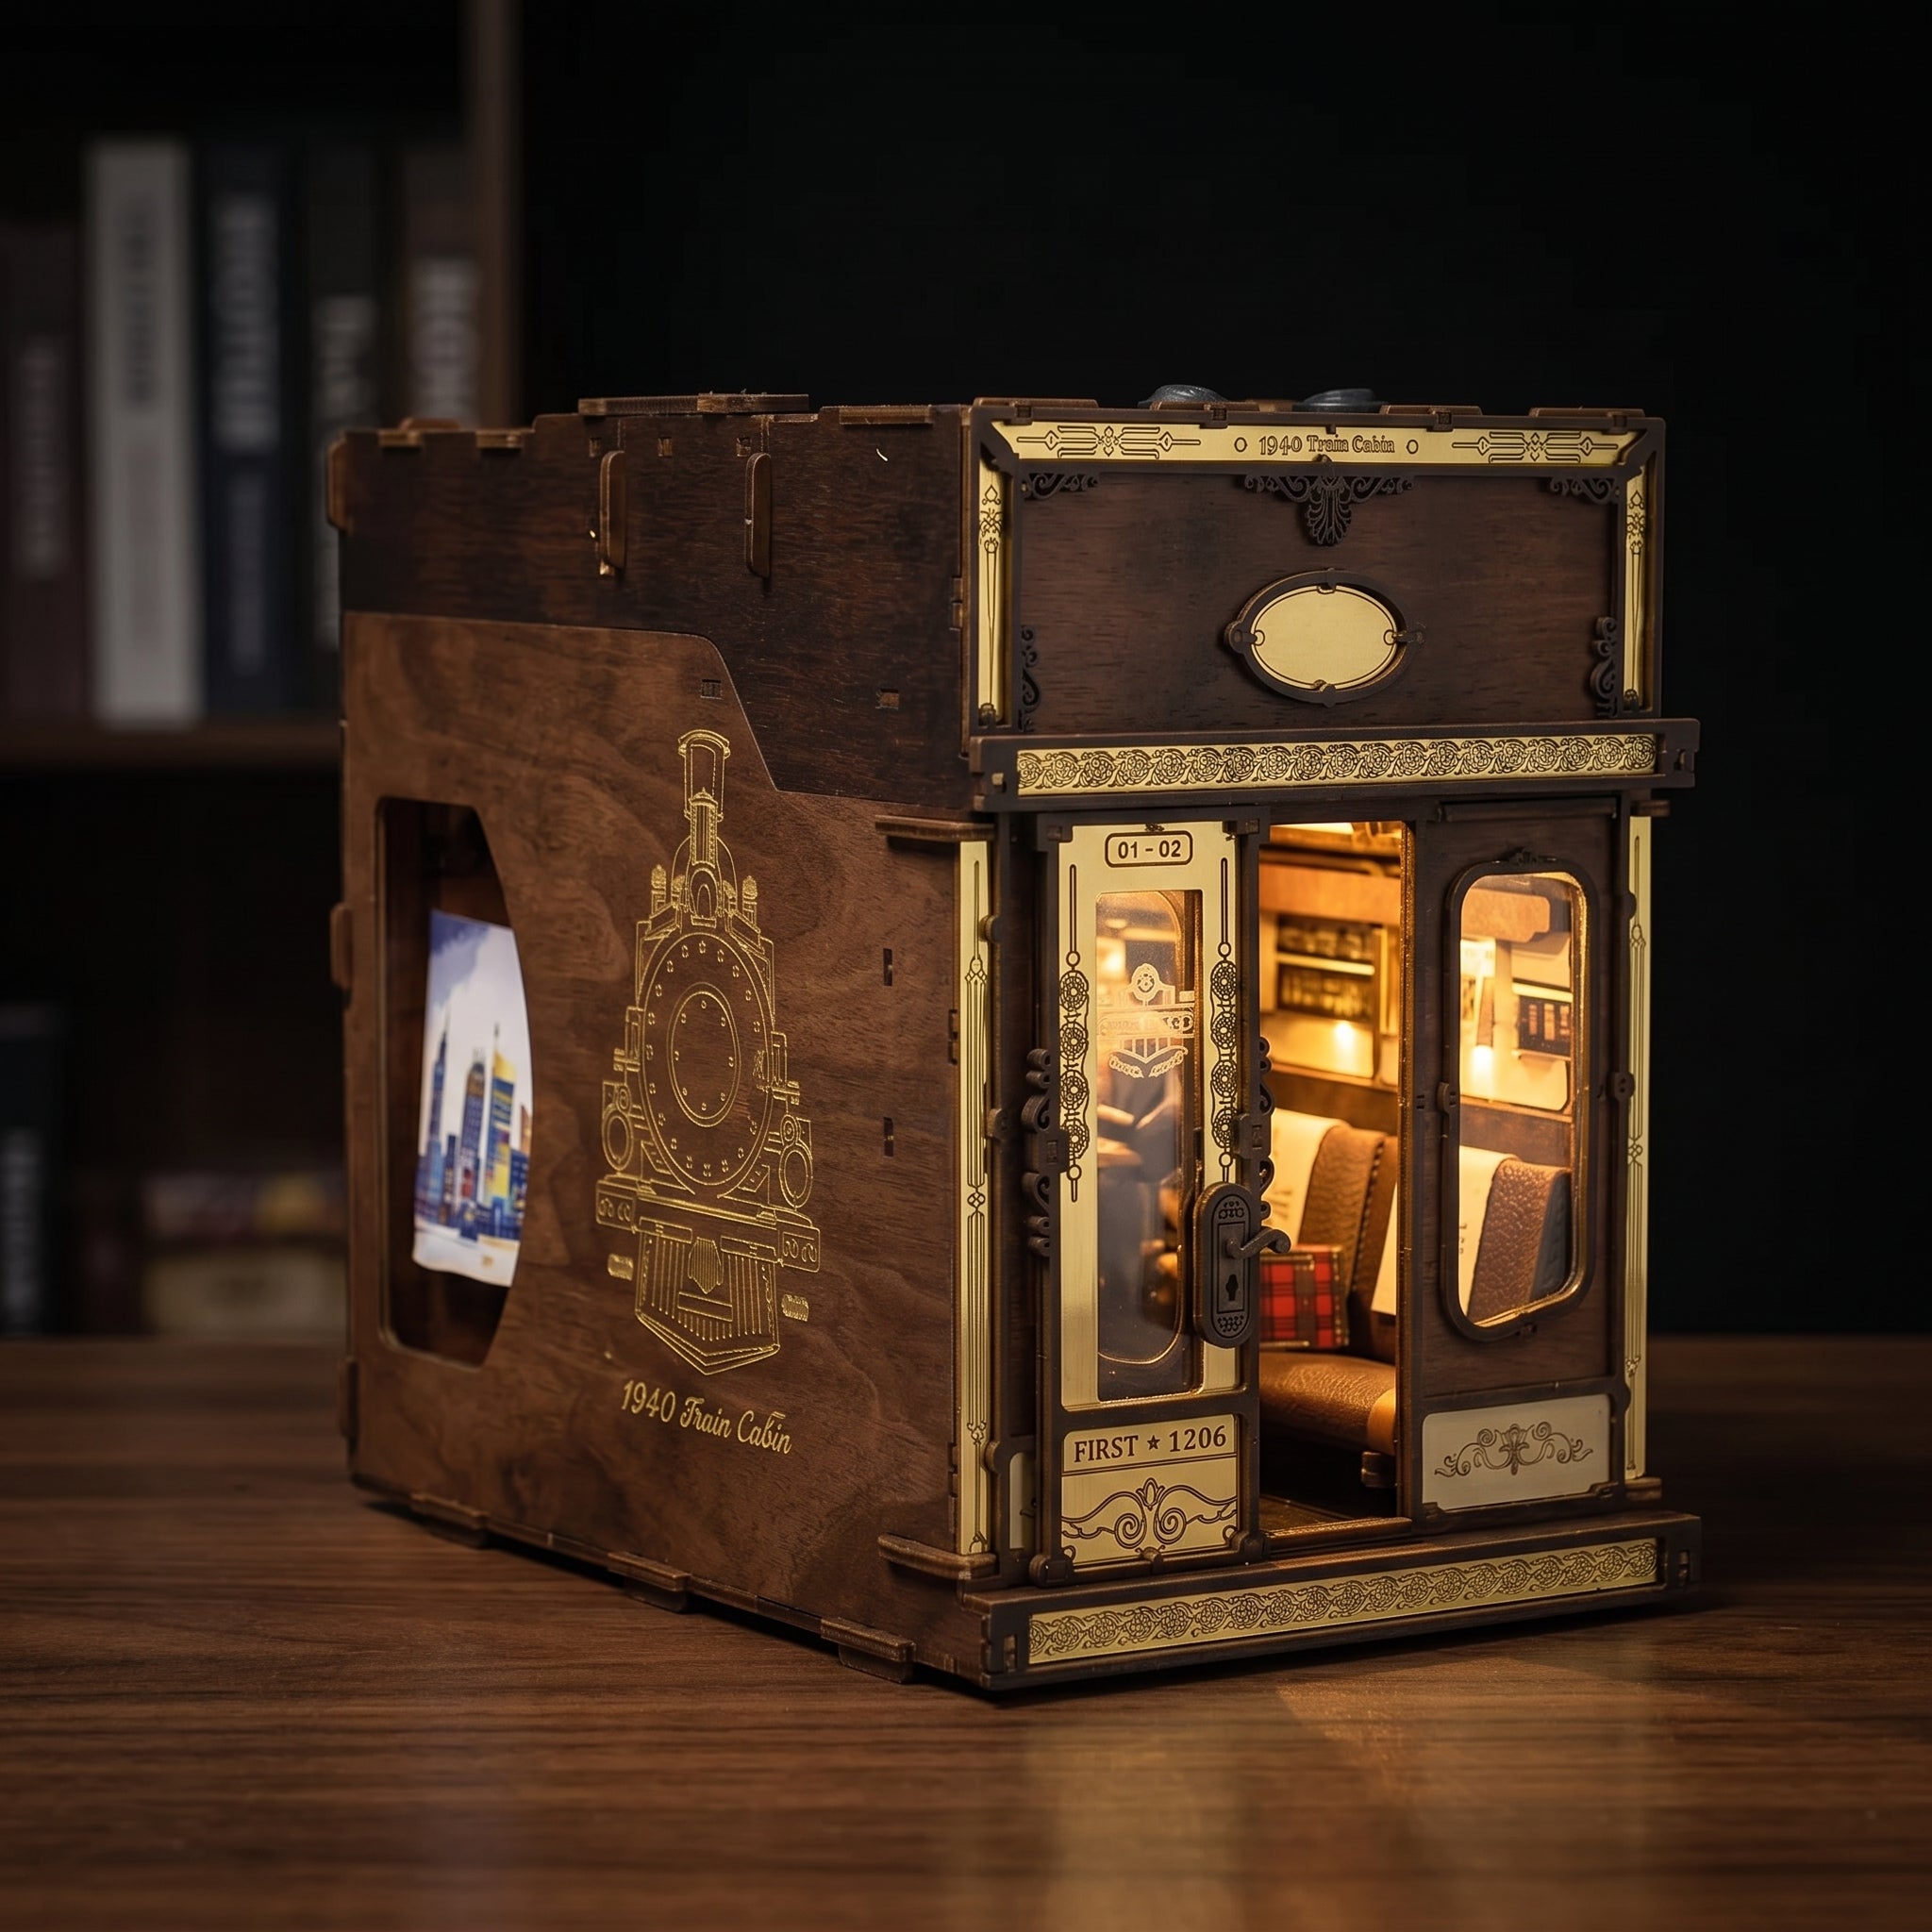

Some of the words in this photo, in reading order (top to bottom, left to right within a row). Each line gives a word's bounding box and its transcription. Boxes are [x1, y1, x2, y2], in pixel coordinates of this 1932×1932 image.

[1258, 435, 1303, 456] 1940
[1306, 434, 1349, 453] Train
[1352, 435, 1395, 454] Cabin
[621, 1379, 675, 1423] 1940
[679, 1396, 732, 1439] Train
[737, 1409, 792, 1454] Cabin
[1074, 1435, 1139, 1463] FIRST
[1169, 1424, 1226, 1453] 1206
